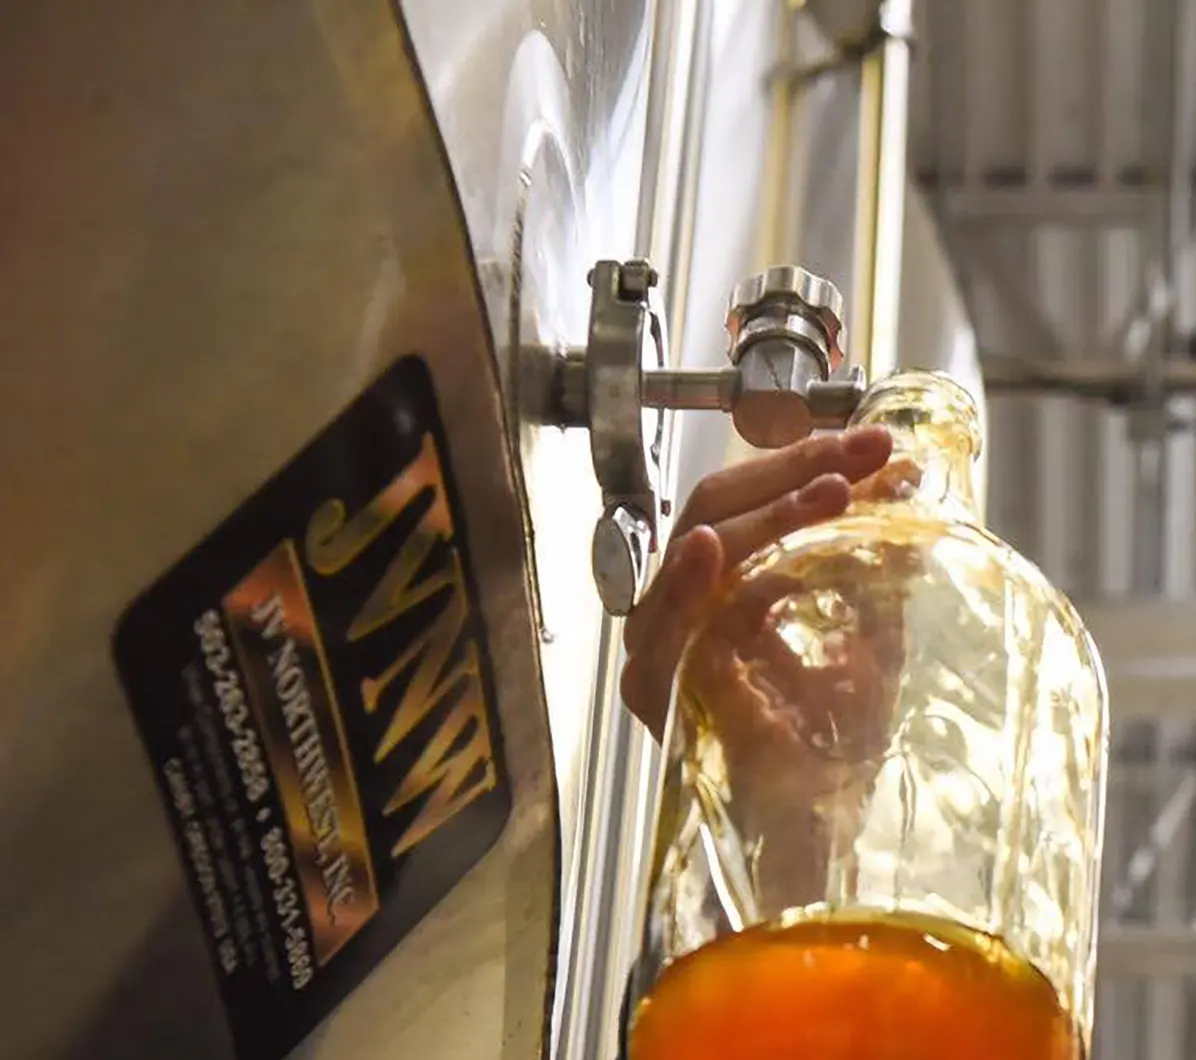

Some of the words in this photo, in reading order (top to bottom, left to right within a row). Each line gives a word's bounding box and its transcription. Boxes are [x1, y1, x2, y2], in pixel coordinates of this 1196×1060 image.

[250, 593, 289, 640] JV
[306, 431, 496, 859] JVNW
[268, 637, 341, 866] NORTHWEST,
